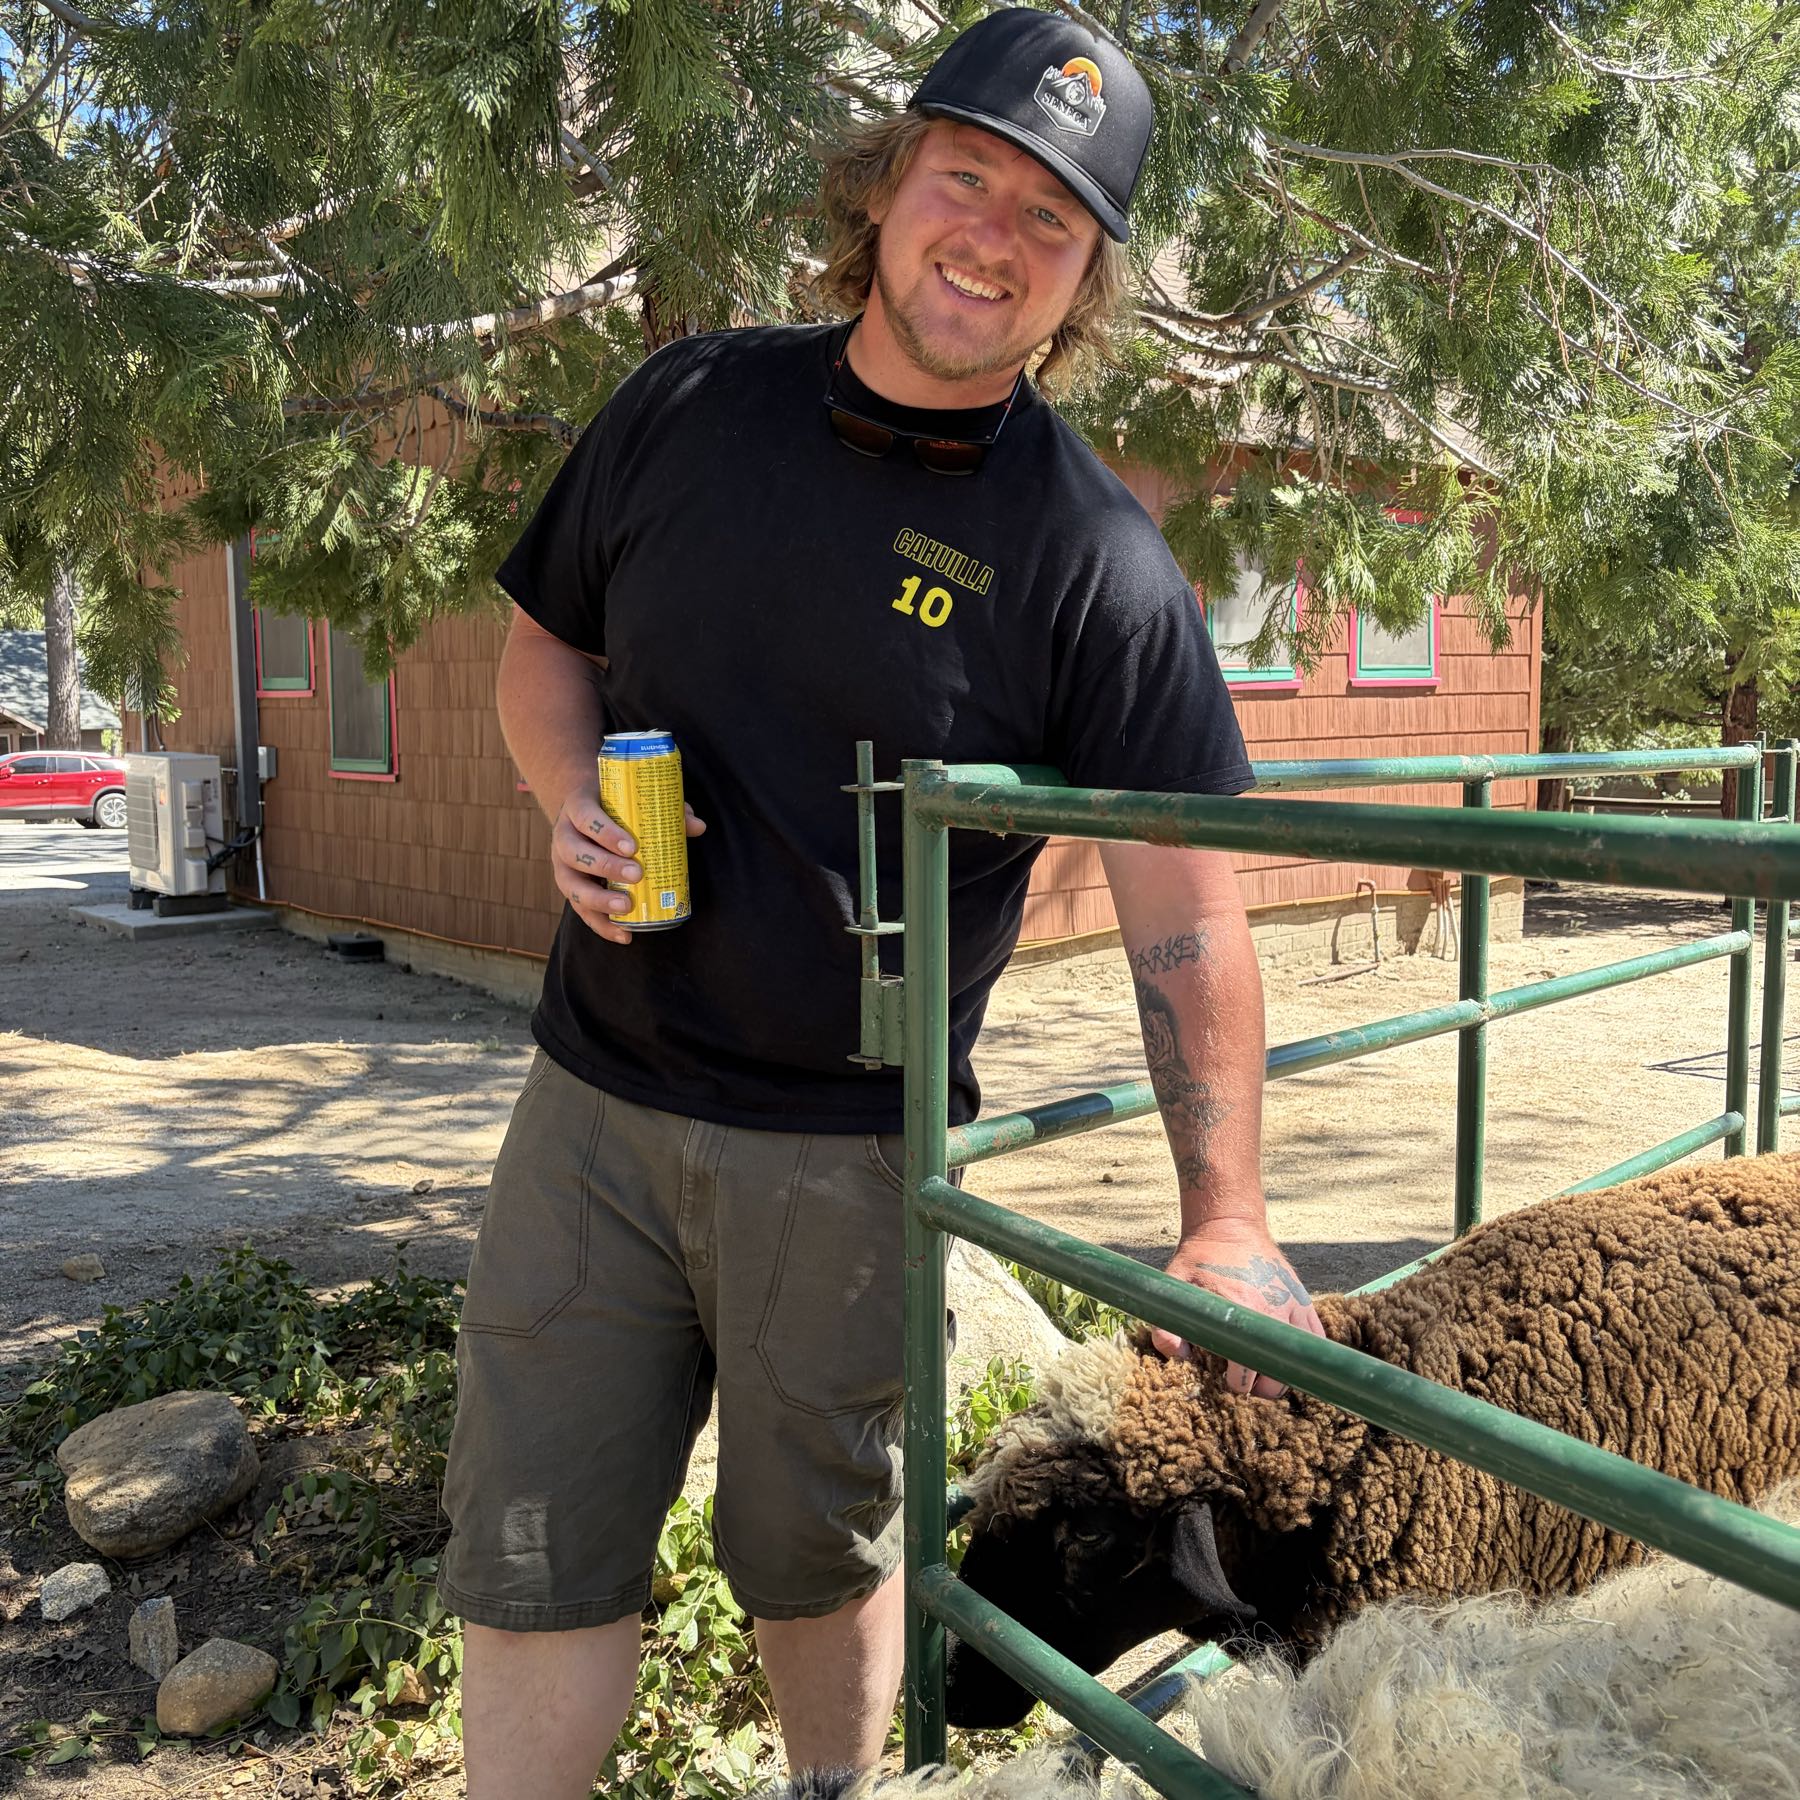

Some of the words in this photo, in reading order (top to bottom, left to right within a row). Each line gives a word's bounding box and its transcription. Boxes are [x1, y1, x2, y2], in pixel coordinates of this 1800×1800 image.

[1042, 93, 1091, 129] SENECA
[893, 527, 995, 596] CAHUILLA
[891, 575, 954, 628] 10
